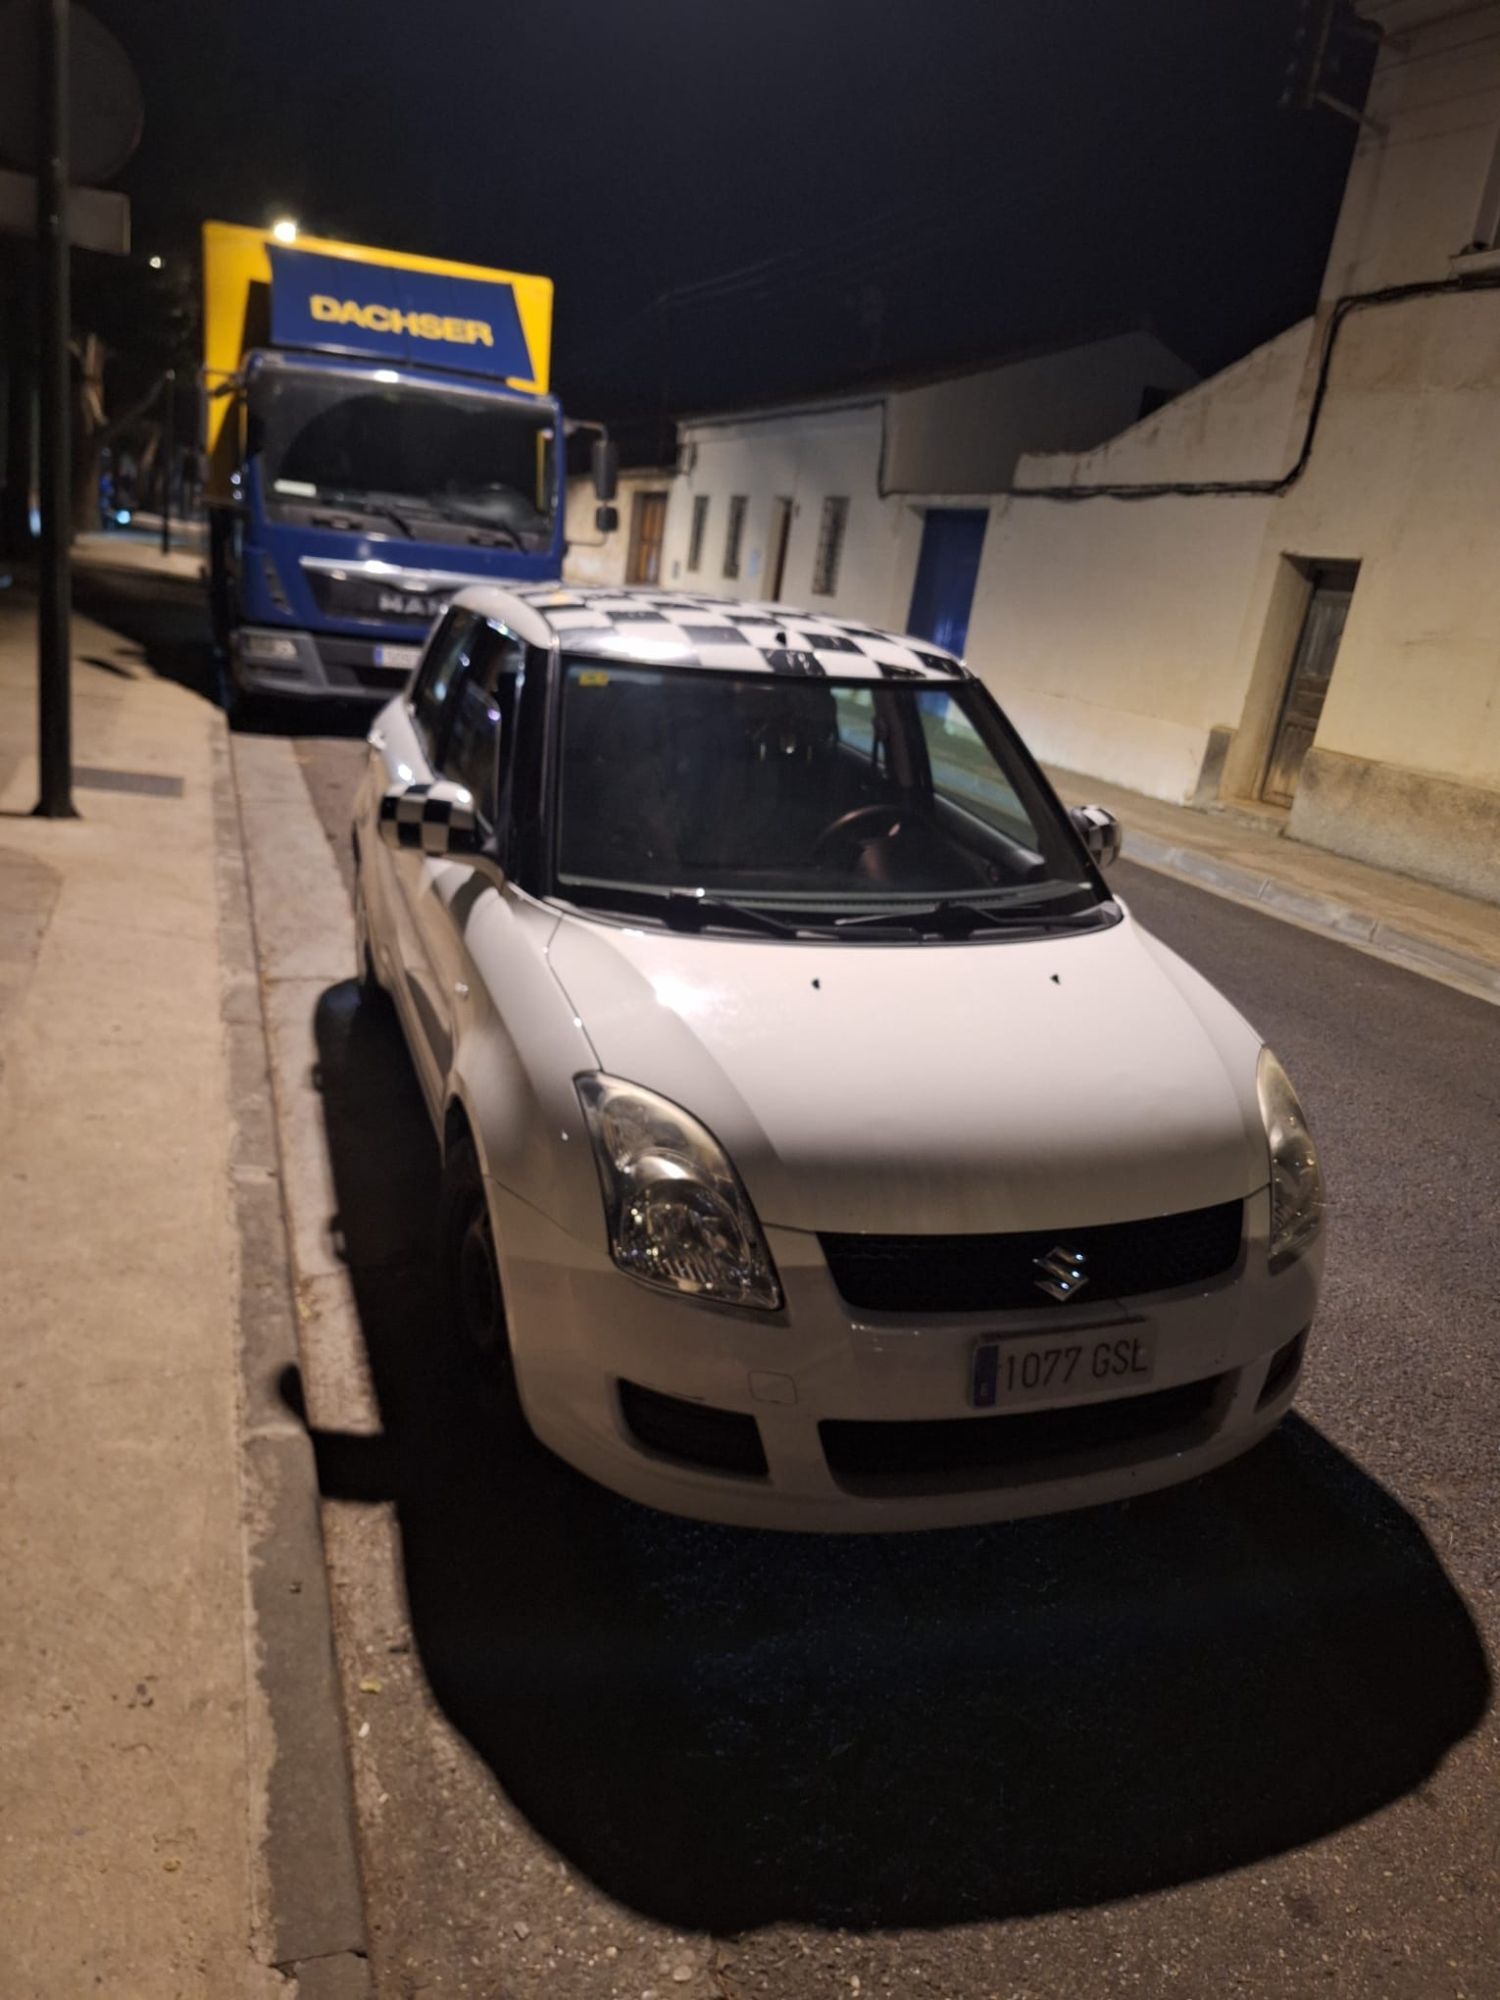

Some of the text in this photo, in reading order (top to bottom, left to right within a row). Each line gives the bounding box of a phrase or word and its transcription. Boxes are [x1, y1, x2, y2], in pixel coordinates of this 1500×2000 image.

[309, 294, 494, 347] DACHSER
[1007, 1338, 1148, 1391] 1077 GSL
